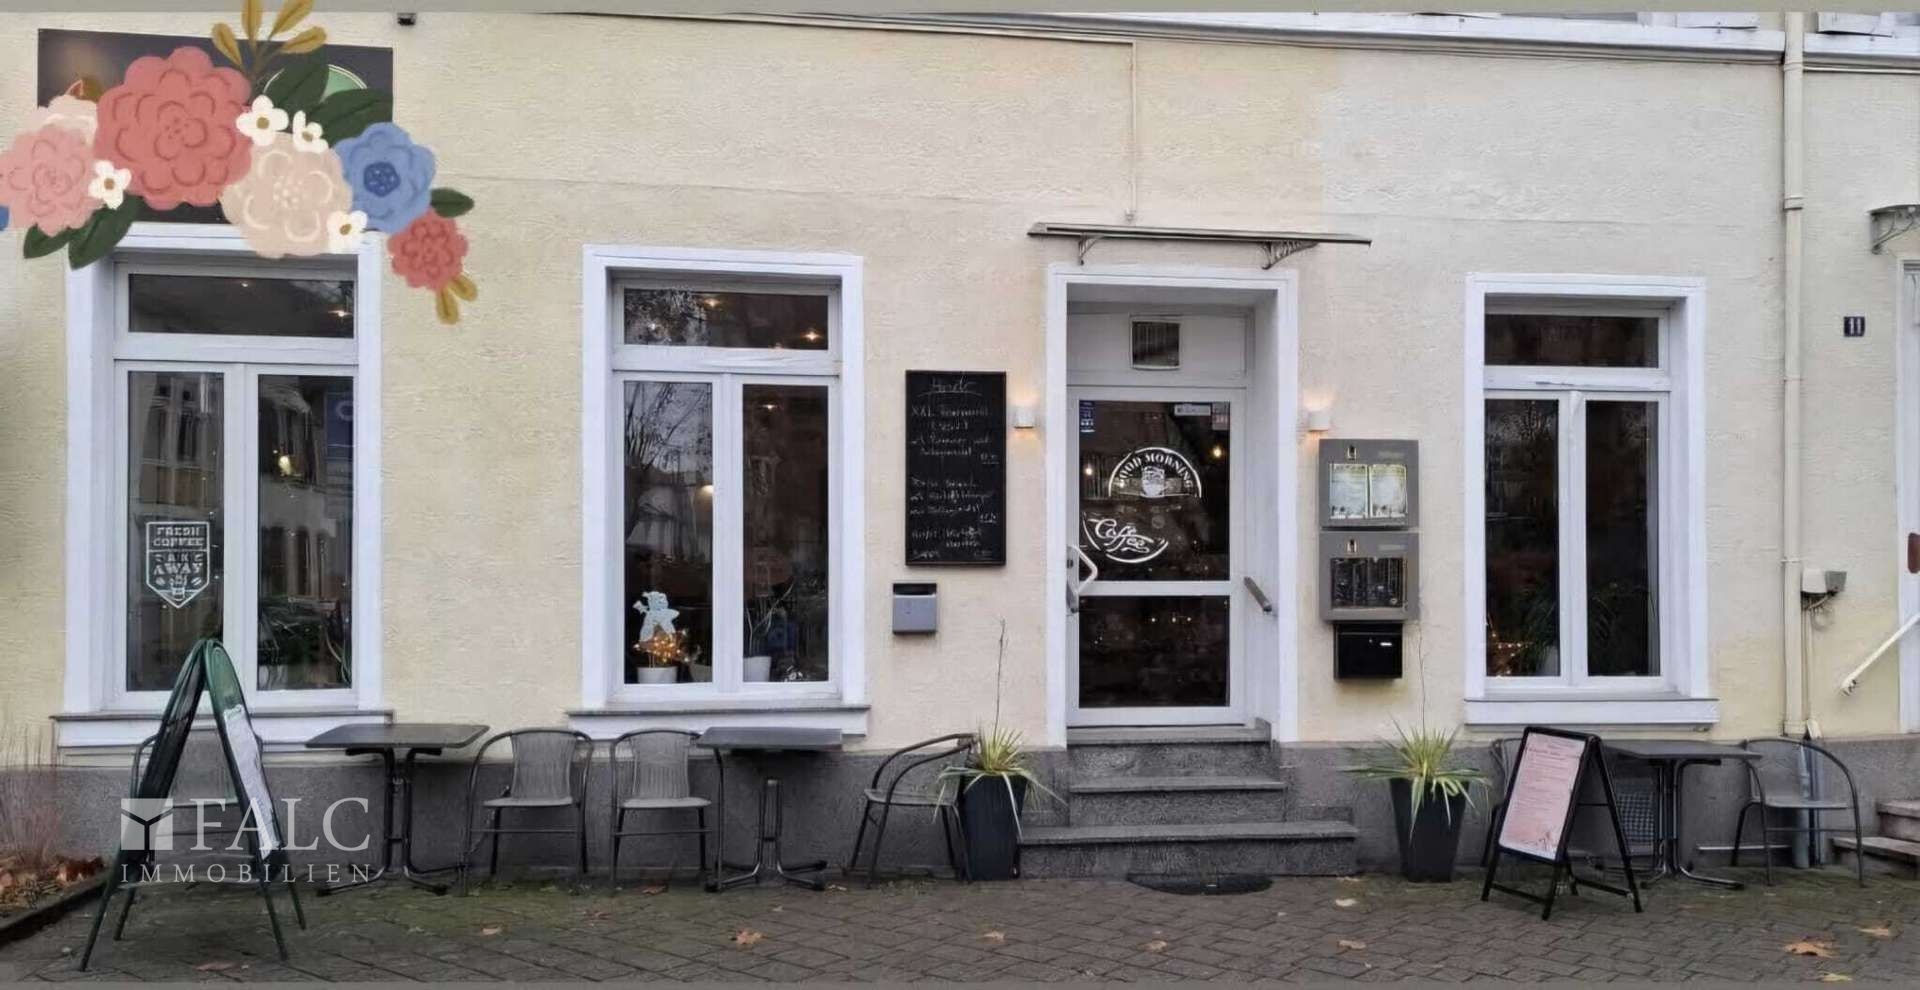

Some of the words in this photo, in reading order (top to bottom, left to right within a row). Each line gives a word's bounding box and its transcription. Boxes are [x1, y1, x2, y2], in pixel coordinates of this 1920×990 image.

[1849, 317, 1861, 335] 11
[1112, 457, 1142, 488] OOD
[1144, 452, 1194, 489] MORNING
[156, 526, 200, 536] FRESH
[1088, 518, 1154, 553] Coffee
[153, 537, 205, 547] COFFEE
[153, 563, 204, 575] AWAY
